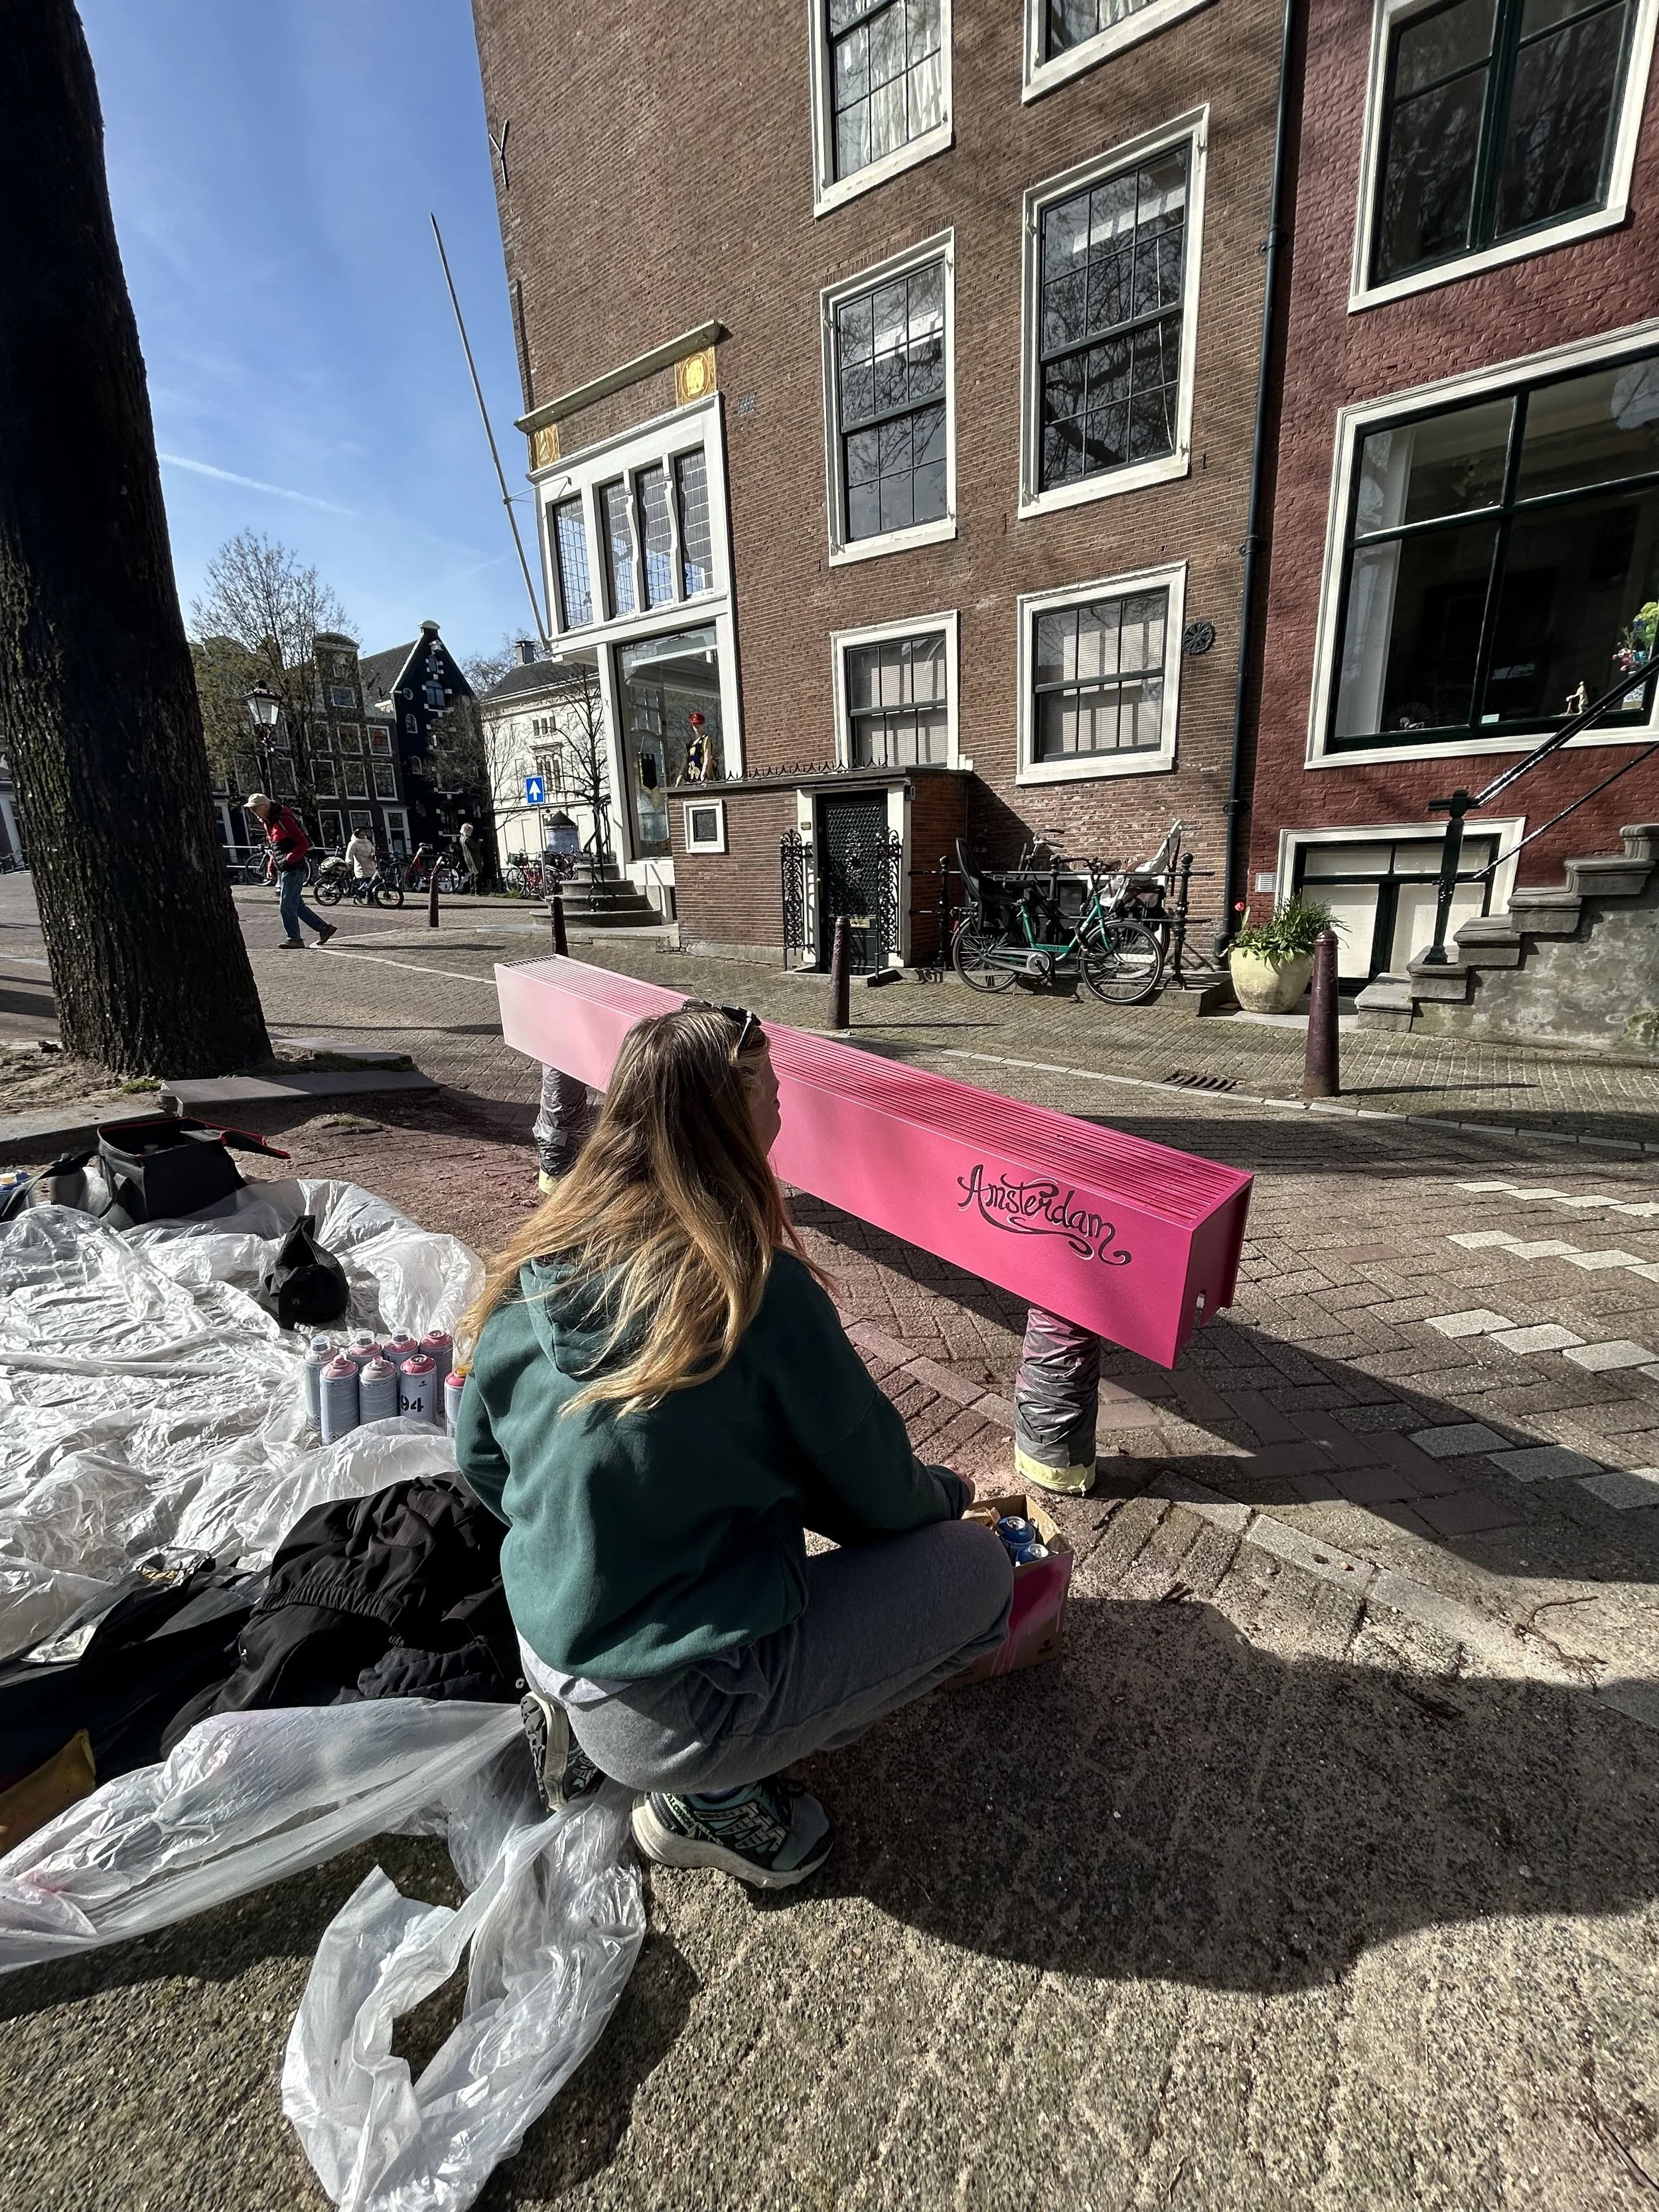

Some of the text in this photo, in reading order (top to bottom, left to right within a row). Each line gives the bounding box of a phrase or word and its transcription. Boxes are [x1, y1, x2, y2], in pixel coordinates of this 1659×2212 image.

[957, 1164, 1131, 1266] Amsterdam
[401, 1394, 424, 1412] 94
[666, 1791, 695, 1828] ALOMON
